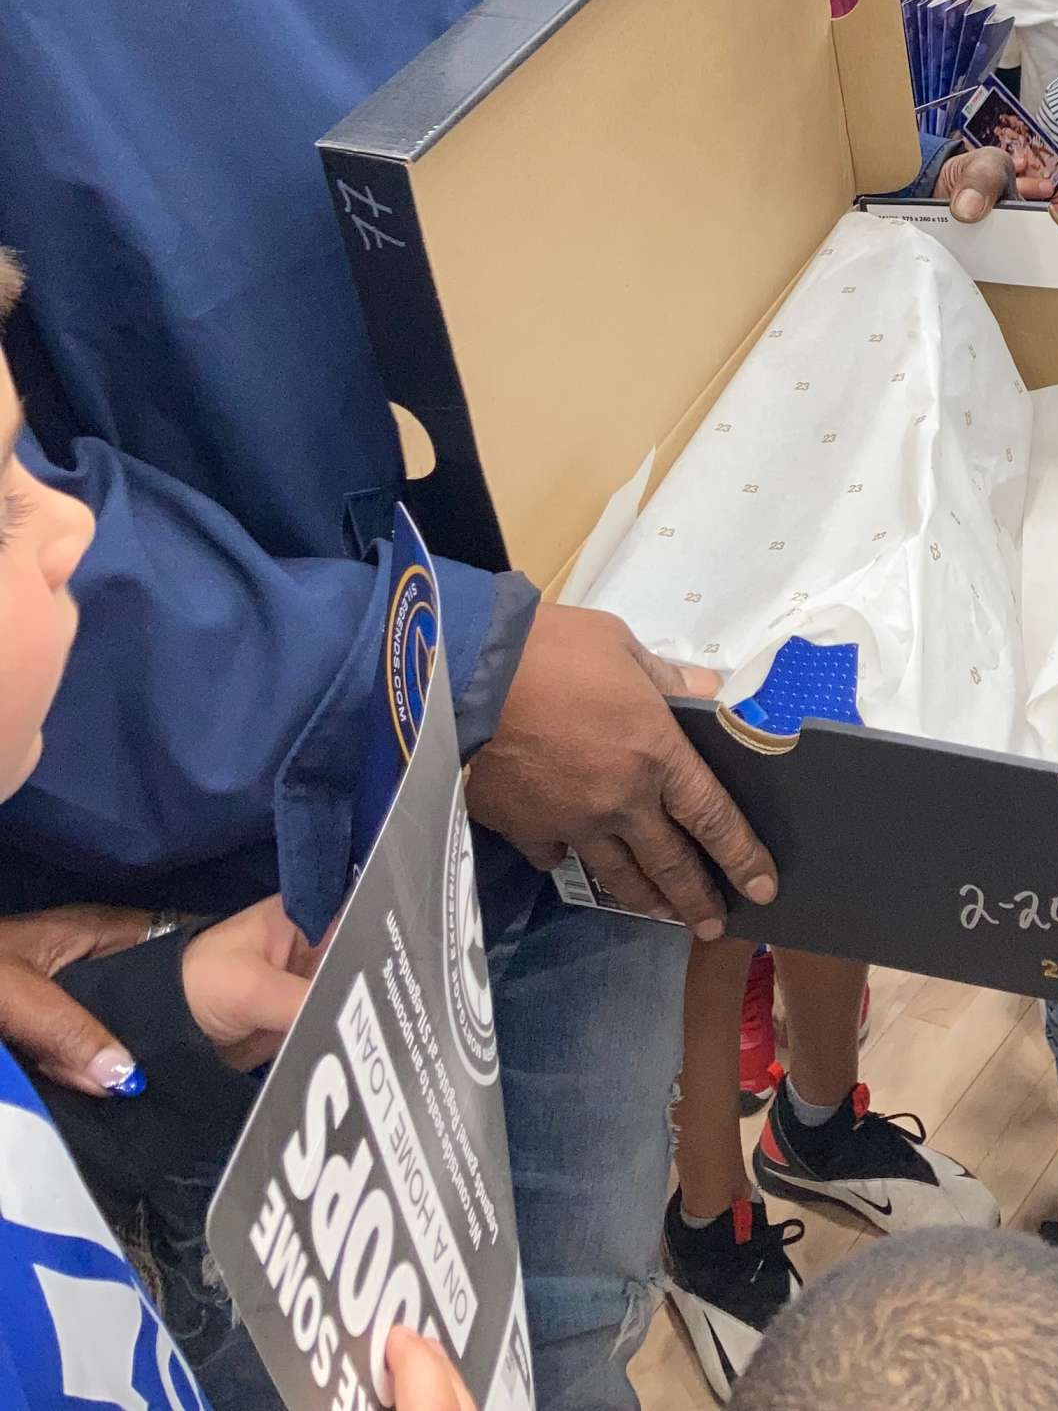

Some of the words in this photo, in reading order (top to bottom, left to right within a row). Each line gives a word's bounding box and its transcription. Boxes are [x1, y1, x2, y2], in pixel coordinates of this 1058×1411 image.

[868, 333, 885, 343] 23
[794, 382, 811, 391] 23
[714, 422, 733, 433] 23
[821, 433, 838, 444] 23
[742, 483, 760, 494] 23
[847, 483, 864, 493] 23
[657, 526, 676, 538] 23
[769, 541, 785, 551] 23
[684, 592, 702, 603] 23
[703, 643, 721, 654] 23
[382, 957, 415, 1050] upcoming
[451, 966, 482, 1059] MORTGAGE
[349, 997, 396, 1122] LOAN
[411, 1043, 423, 1073] an
[389, 1118, 437, 1238] HOME
[441, 1132, 471, 1211] courtside
[474, 1171, 499, 1246] Legends
[283, 1052, 440, 1409] OOPS
[431, 1226, 449, 1263] A
[467, 1206, 482, 1252] Win
[249, 1177, 340, 1388] SOME
[443, 1261, 469, 1325] ON
